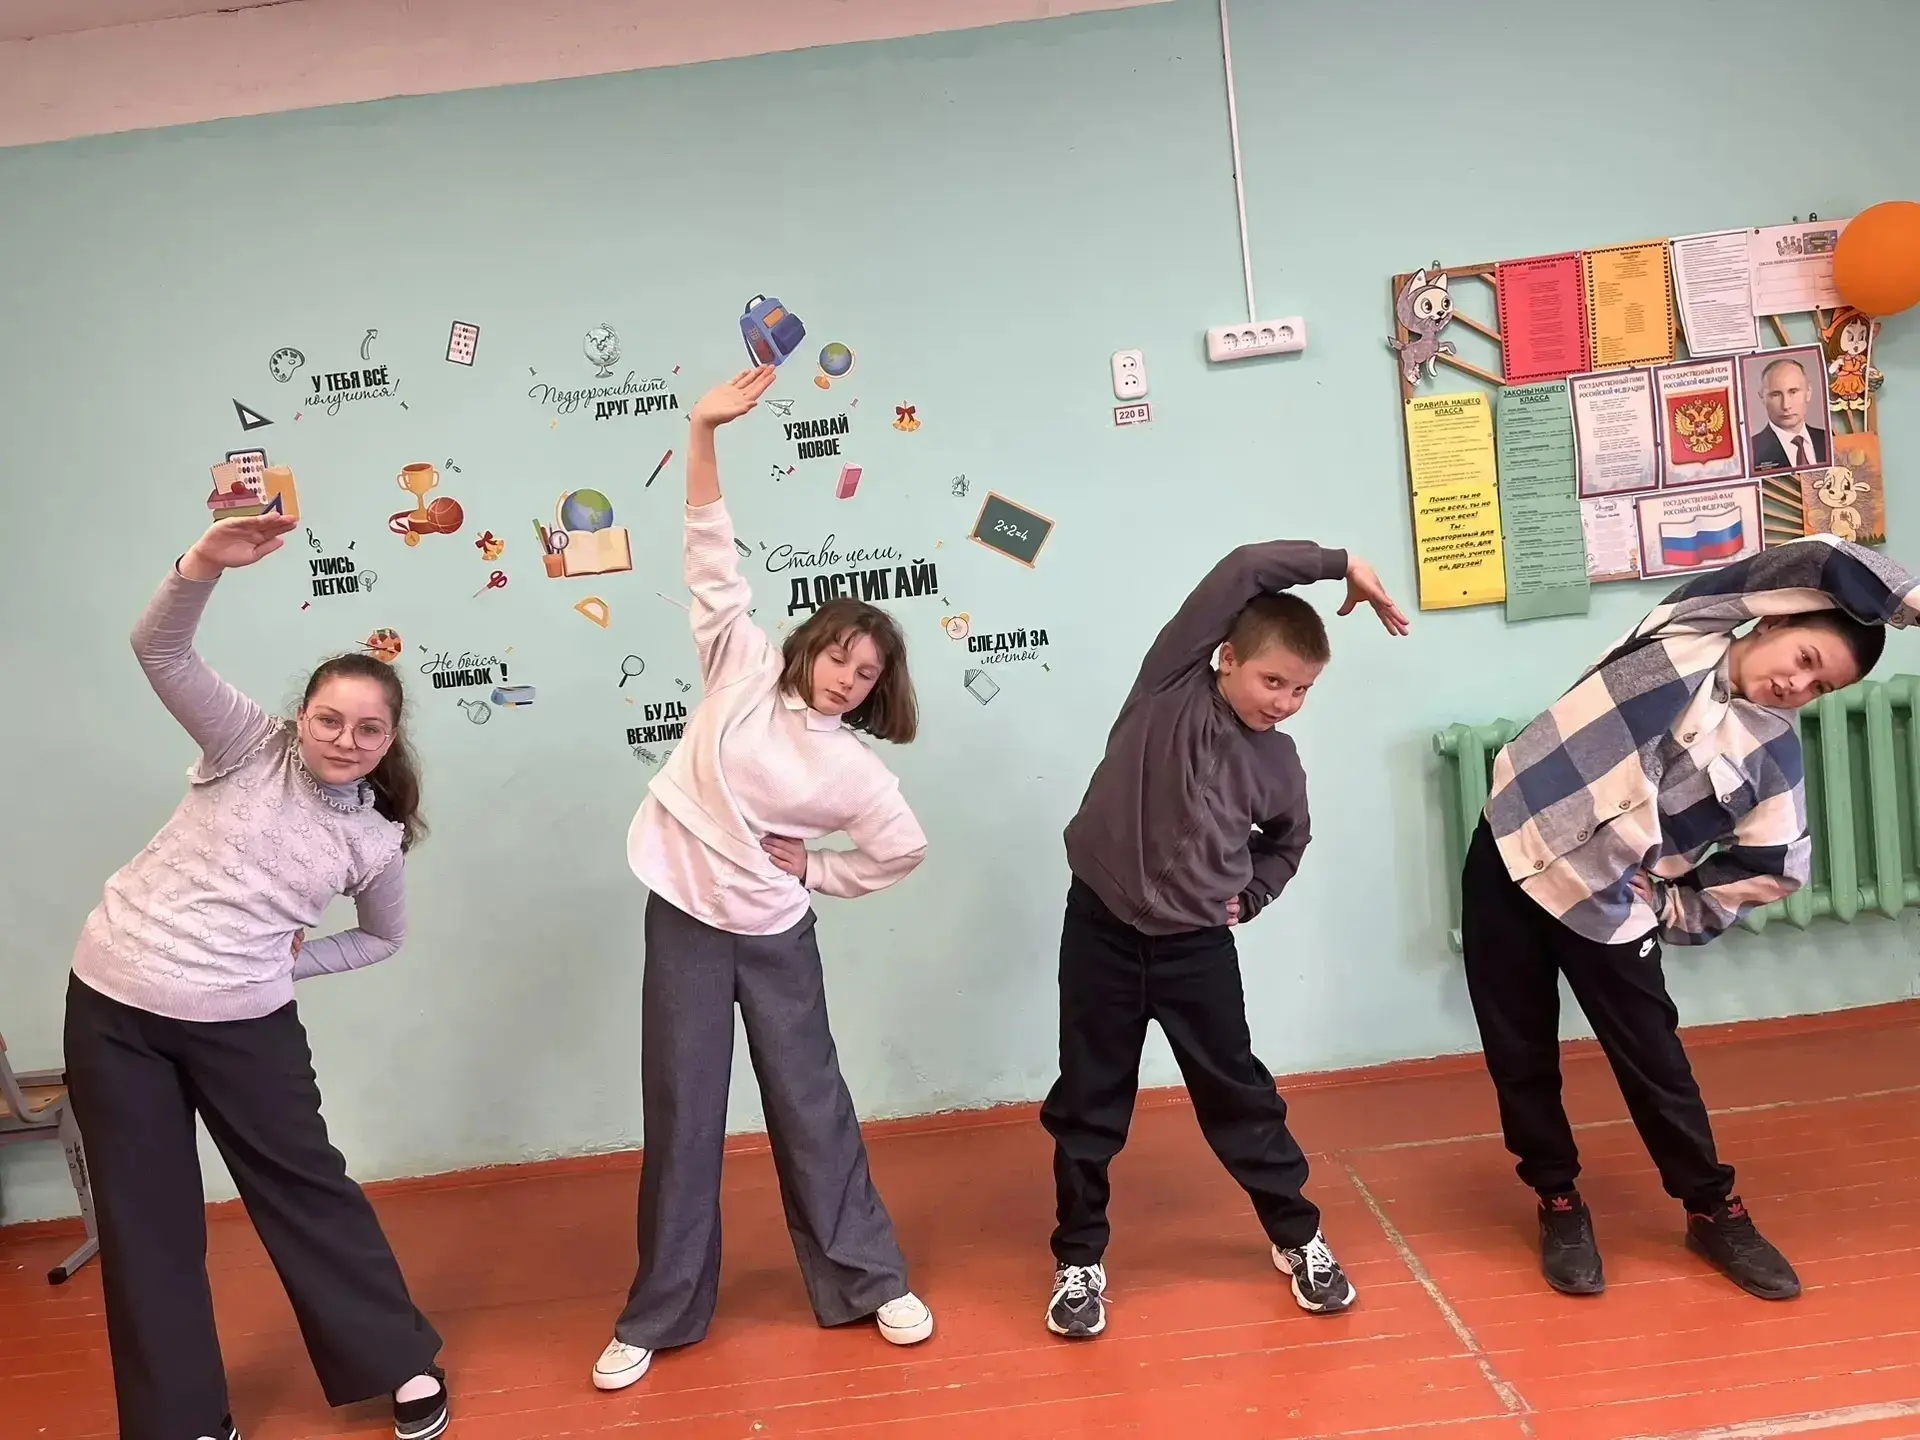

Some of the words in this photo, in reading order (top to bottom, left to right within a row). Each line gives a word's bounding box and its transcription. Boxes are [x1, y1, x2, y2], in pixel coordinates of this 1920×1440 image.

[311, 374, 321, 393] У
[324, 371, 361, 392] ТЕБЯ
[362, 364, 390, 388] ВСЁ
[304, 378, 400, 416] получится!
[528, 370, 668, 414] Поддерживайте
[1503, 388, 1534, 398] ЗАКОНЫ
[1535, 384, 1566, 394] НАШЕГО
[1519, 394, 1550, 404] КЛАССА
[595, 399, 630, 421] ДРУГ
[634, 393, 679, 417] ДРУГА
[1119, 409, 1136, 420] 220
[1413, 400, 1450, 410] ПРАВИЛА
[1451, 397, 1481, 405] НАШЕГО
[1434, 407, 1464, 416] КЛАССА
[783, 413, 850, 441] УЗНАВАЙ
[797, 438, 841, 460] НОВОЕ
[993, 519, 1029, 541] 2+2=4
[1421, 530, 1479, 543] неповторимый
[1479, 529, 1495, 537] для
[765, 533, 843, 573] Ставь
[845, 546, 903, 569] цели,
[1425, 545, 1454, 553] самого
[308, 556, 355, 577] УЧИСЬ
[312, 575, 360, 597] ЛЕГКО!
[787, 557, 939, 617] ДОСТИГАЙ!
[967, 627, 1027, 654] СЛЕДУЙ
[1029, 629, 1050, 647] ЗА
[420, 651, 455, 675] Не
[457, 651, 501, 669] бойся
[980, 647, 1040, 665] мечтой
[432, 667, 493, 689] ОШИБОК
[643, 700, 688, 723] БУДЬ
[626, 721, 688, 745] ВЕЖЛИВ
